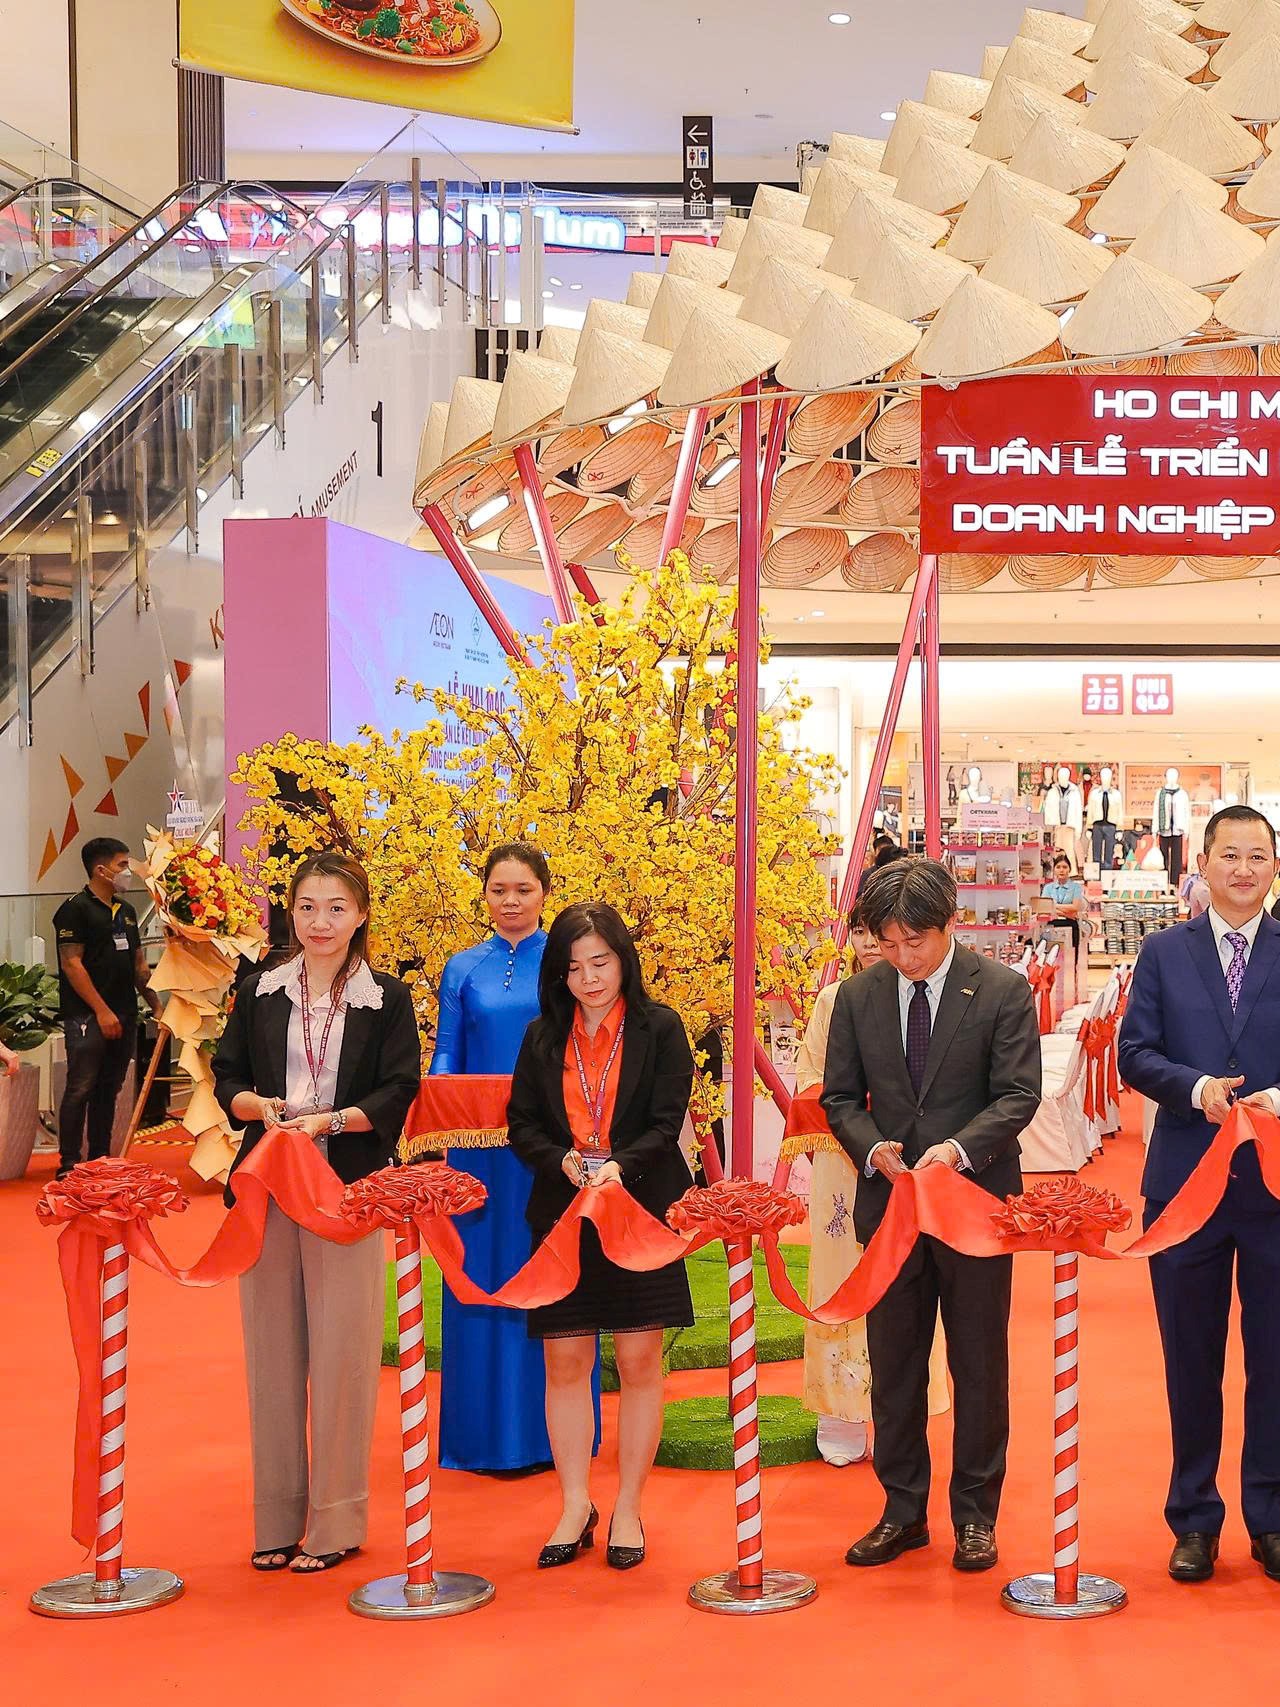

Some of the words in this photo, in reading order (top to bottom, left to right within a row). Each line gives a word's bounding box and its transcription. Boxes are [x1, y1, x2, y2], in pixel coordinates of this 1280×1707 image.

[1093, 389, 1157, 419] HO
[1170, 390, 1239, 419] CHI
[371, 400, 383, 477] 1
[936, 436, 1061, 475] TUẦN
[1073, 434, 1128, 476] LỄ
[1140, 437, 1269, 477] TRIỂN
[310, 450, 358, 518] AMUSEMENT
[952, 503, 1105, 534] DOANH
[1117, 498, 1275, 541] NGHIỆP
